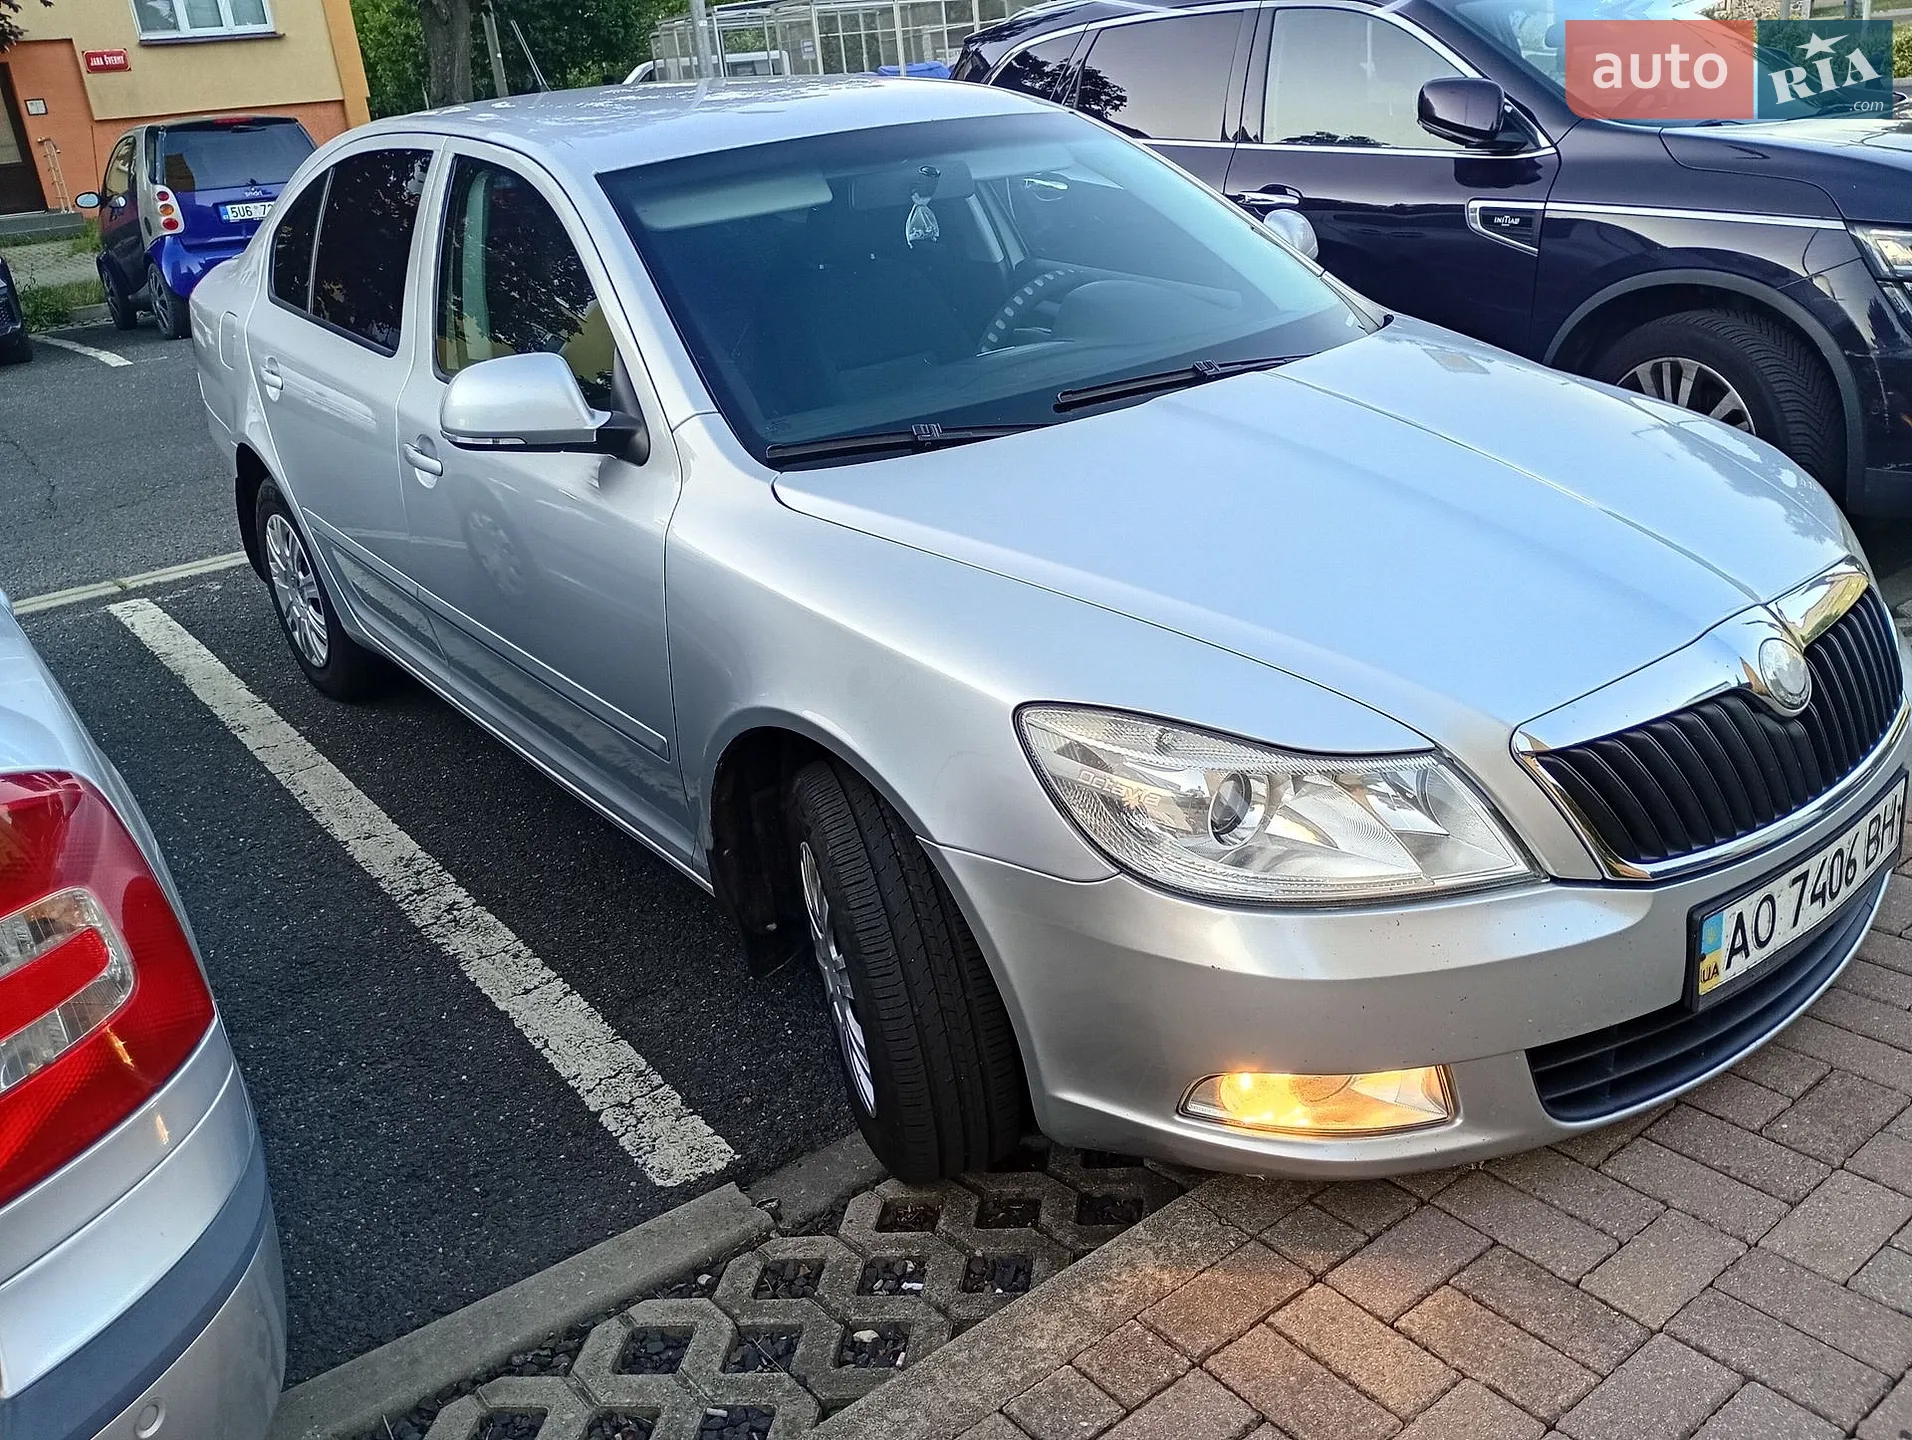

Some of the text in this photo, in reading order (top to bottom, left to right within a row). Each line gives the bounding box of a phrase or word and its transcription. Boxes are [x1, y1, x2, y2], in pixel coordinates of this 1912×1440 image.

[230, 205, 253, 218] 5U6
[1724, 793, 1897, 971] AO 7406 BH
[1700, 962, 1720, 982] UA
